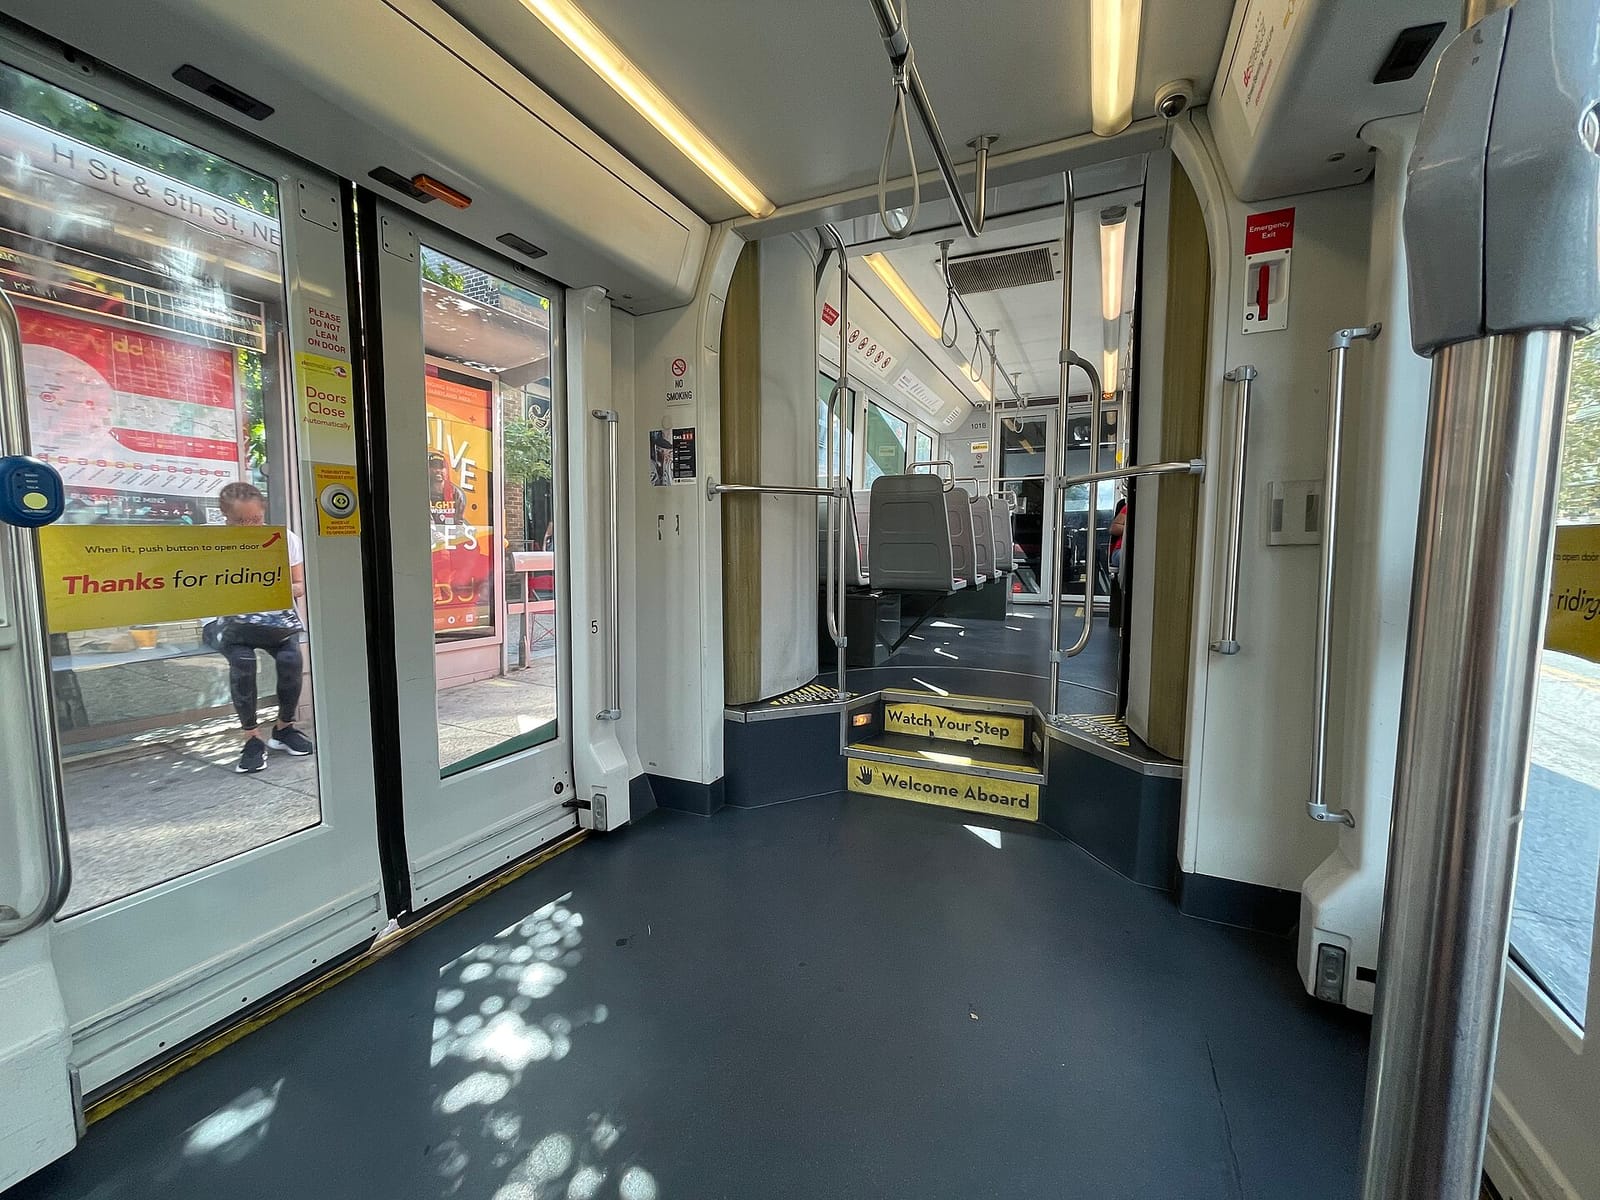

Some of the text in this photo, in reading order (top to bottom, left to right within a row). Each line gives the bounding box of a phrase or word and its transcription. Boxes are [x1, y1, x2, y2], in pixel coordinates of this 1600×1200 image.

[52, 142, 281, 247] H St & 5th St, NE
[1249, 221, 1290, 233] Emergency
[1261, 231, 1276, 239] Exit
[308, 307, 341, 323] PLEASE
[309, 317, 341, 333] DO NOT
[315, 329, 338, 342] LEAN
[307, 337, 346, 354] ON DOOR
[674, 379, 684, 389] NO
[305, 386, 347, 404] Doors
[666, 390, 693, 402] SMOKING
[308, 401, 345, 418] Close
[85, 545, 118, 554] When
[121, 544, 135, 554] lit,
[138, 544, 164, 555] push
[166, 544, 200, 552] button
[214, 544, 237, 553] open
[239, 543, 259, 551] door
[1562, 554, 1580, 563] open
[62, 566, 282, 595] Thanks for riding!
[591, 620, 598, 634] 5
[887, 709, 1010, 741] Watch Your Step
[881, 772, 1030, 809] Welcome Aboard
